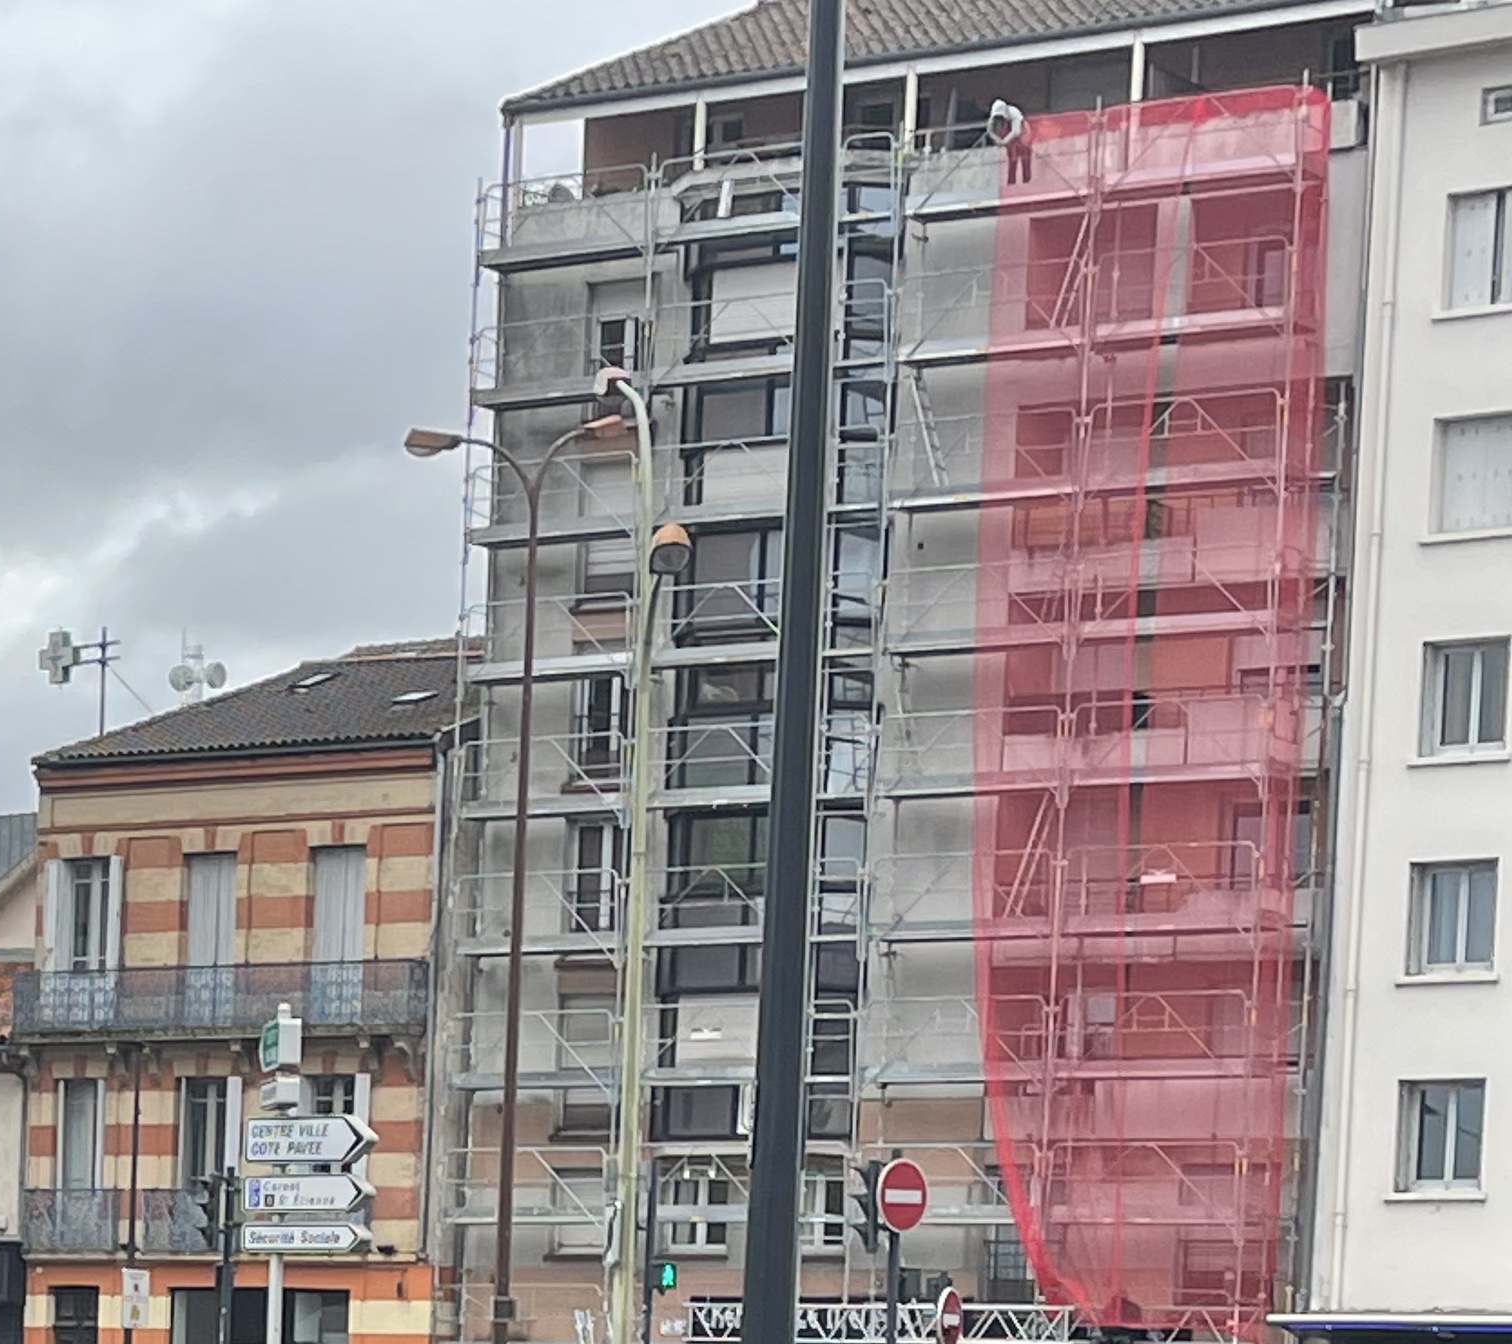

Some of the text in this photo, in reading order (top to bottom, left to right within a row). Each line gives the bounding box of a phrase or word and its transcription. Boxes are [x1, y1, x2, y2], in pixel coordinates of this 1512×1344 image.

[251, 1123, 329, 1138] CENTRE VILLE
[301, 1230, 340, 1244] Sociale
